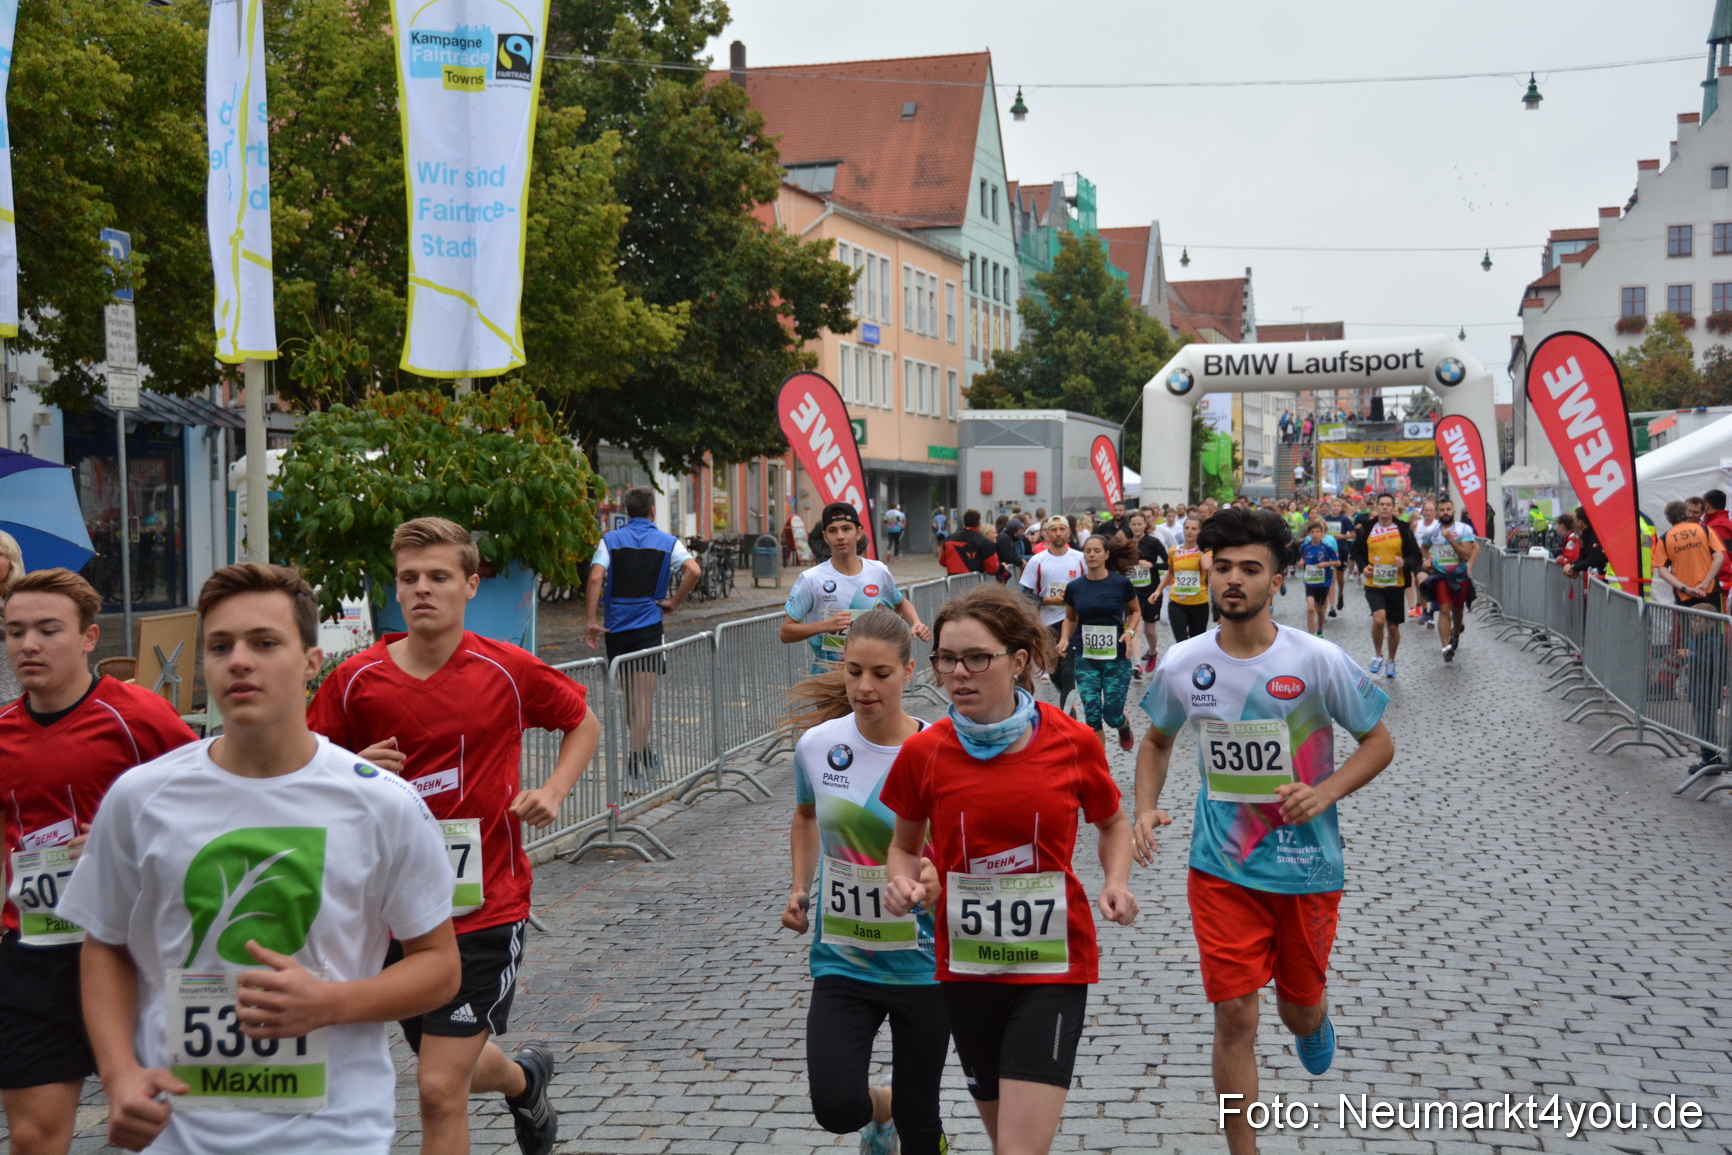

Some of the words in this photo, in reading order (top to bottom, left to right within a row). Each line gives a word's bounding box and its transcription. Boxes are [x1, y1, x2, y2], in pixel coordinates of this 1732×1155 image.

[411, 32, 482, 50] Kampagne
[412, 46, 490, 65] Fairtrade
[444, 70, 484, 85] Towns
[497, 70, 531, 81] FAIRTRADE
[417, 161, 459, 185] Wir
[464, 165, 506, 188] sind
[1204, 353, 1279, 376] BMW
[1287, 348, 1425, 376] Laufsport
[19, 433, 30, 454] 3
[1364, 445, 1390, 455] ZIEL
[1671, 529, 1697, 542] TSV
[1673, 541, 1703, 554] Dietfurt
[1375, 569, 1397, 578] 5242
[1176, 577, 1197, 587] 5222
[1085, 633, 1113, 647] 5033
[1271, 681, 1301, 694] Hervis
[1234, 722, 1280, 734] BOCK
[1210, 740, 1283, 771] 5302
[417, 778, 442, 793] DEHN
[822, 780, 850, 789] Neumarkt
[823, 772, 850, 784] PARTL
[35, 829, 59, 846] DEHN
[1276, 829, 1297, 845] 17.
[1276, 845, 1322, 854] Neumarkter
[986, 855, 1016, 870] DEHN
[1276, 855, 1314, 865] Stadtlauf
[957, 884, 993, 892] NeuerMarkt
[1000, 875, 1055, 890] BOCK
[961, 898, 1055, 937] 5197
[853, 923, 881, 939] Jana
[978, 945, 1039, 961] Melanie
[179, 986, 228, 994] NeuerMarkt
[450, 1014, 478, 1023] adidas
[201, 1067, 298, 1094] Maxim
